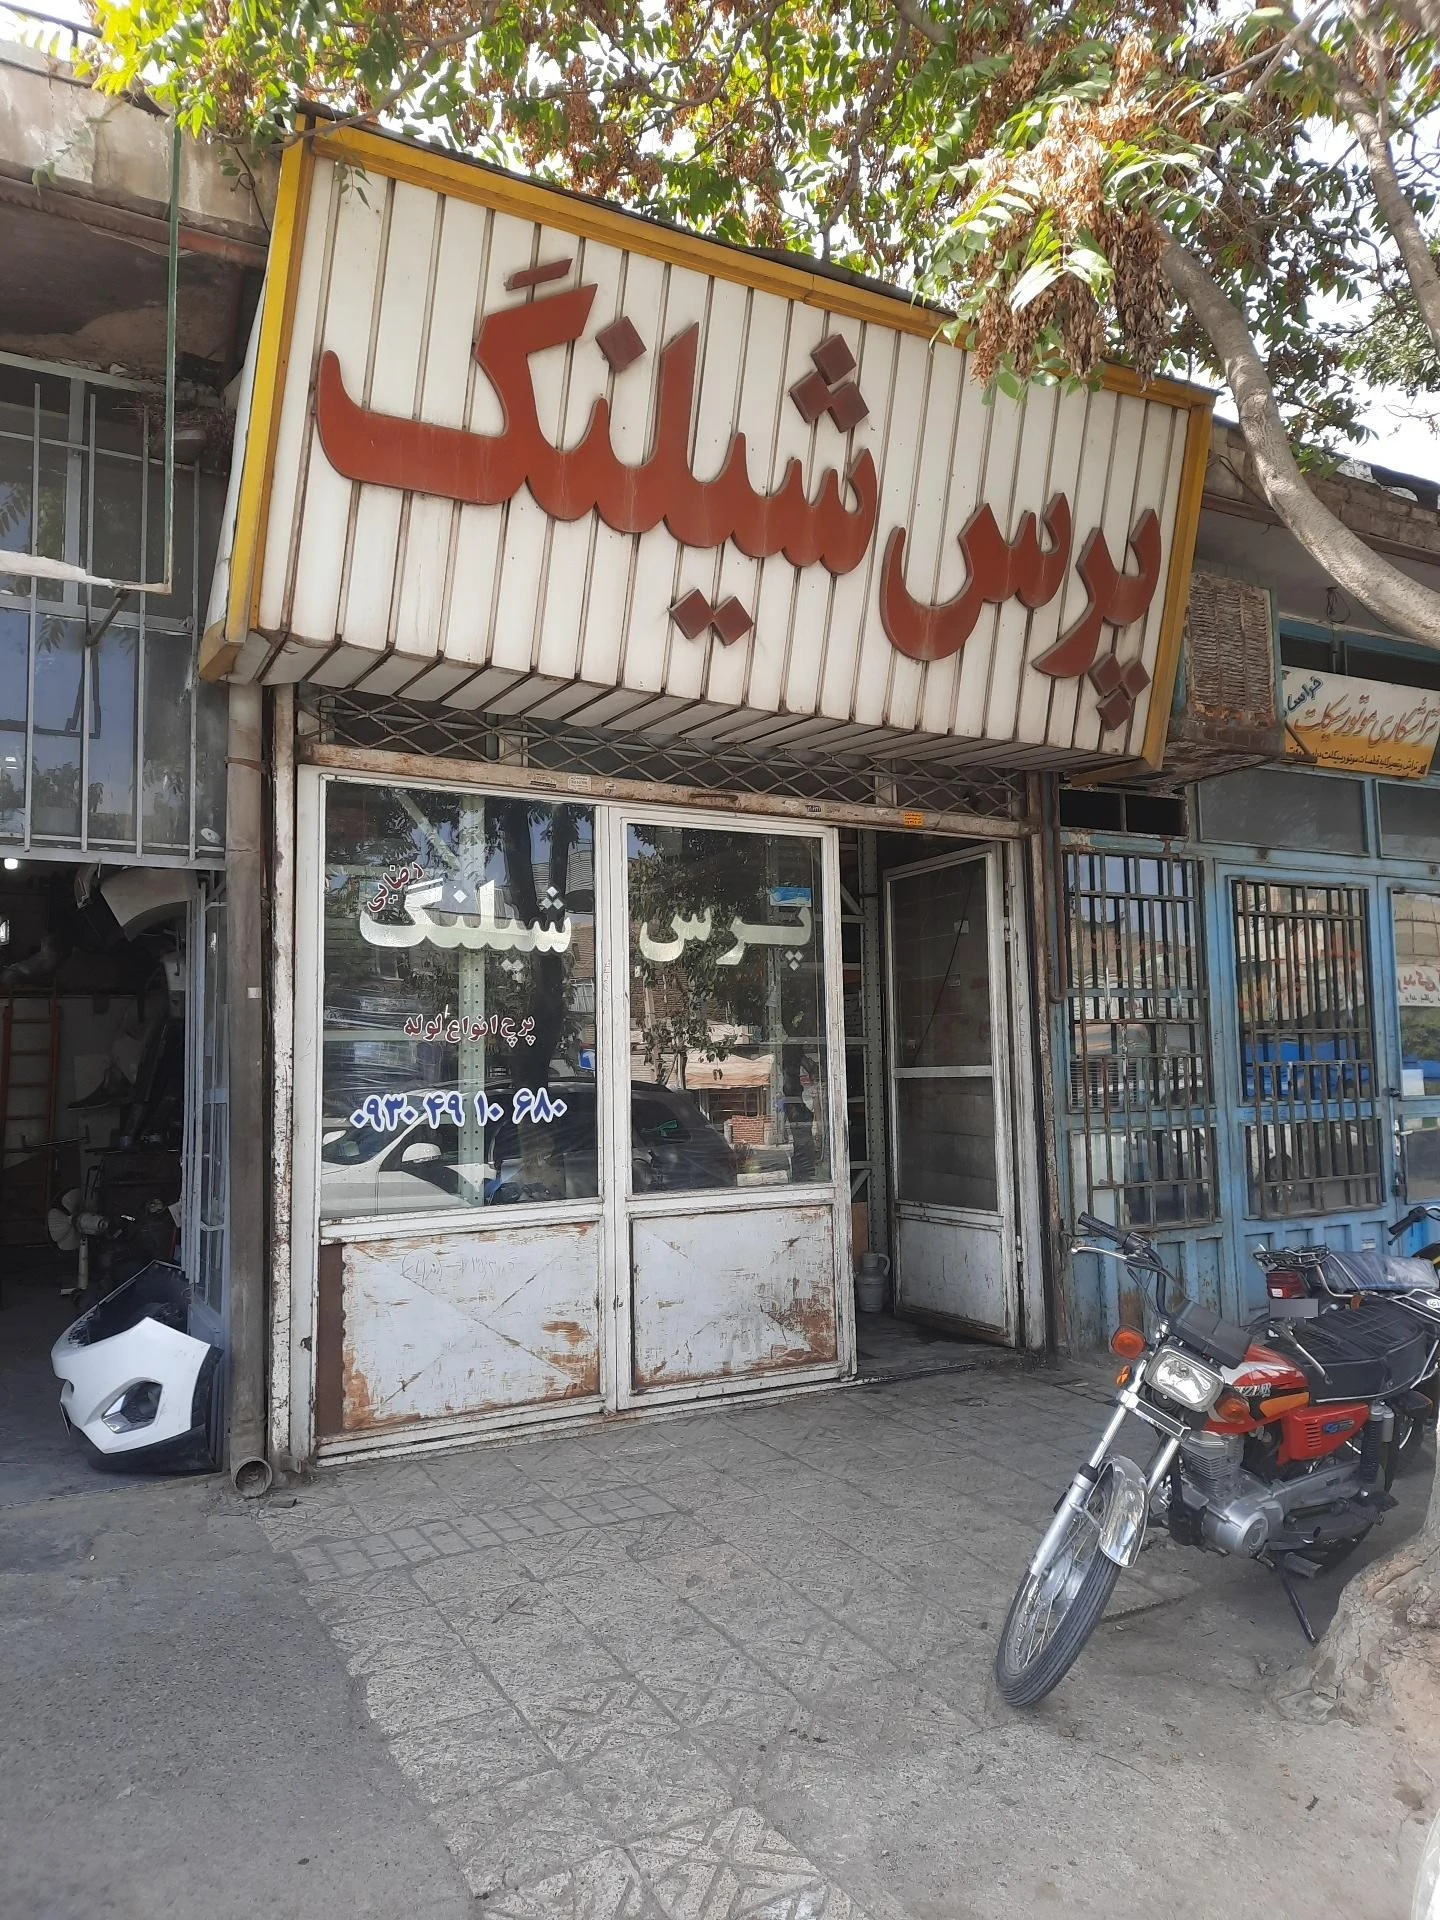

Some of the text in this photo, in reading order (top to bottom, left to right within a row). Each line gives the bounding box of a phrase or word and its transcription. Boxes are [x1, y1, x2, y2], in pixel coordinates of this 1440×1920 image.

[315, 257, 1163, 732] پرس شیلنگ
[359, 878, 572, 984] شیلنگ
[639, 906, 812, 971] پرس
[403, 1013, 536, 1048] پرچ انواع لوله
[350, 1087, 567, 1132] ۰۹۳۰ ۴۹ ۱۰ ۶۸۰
